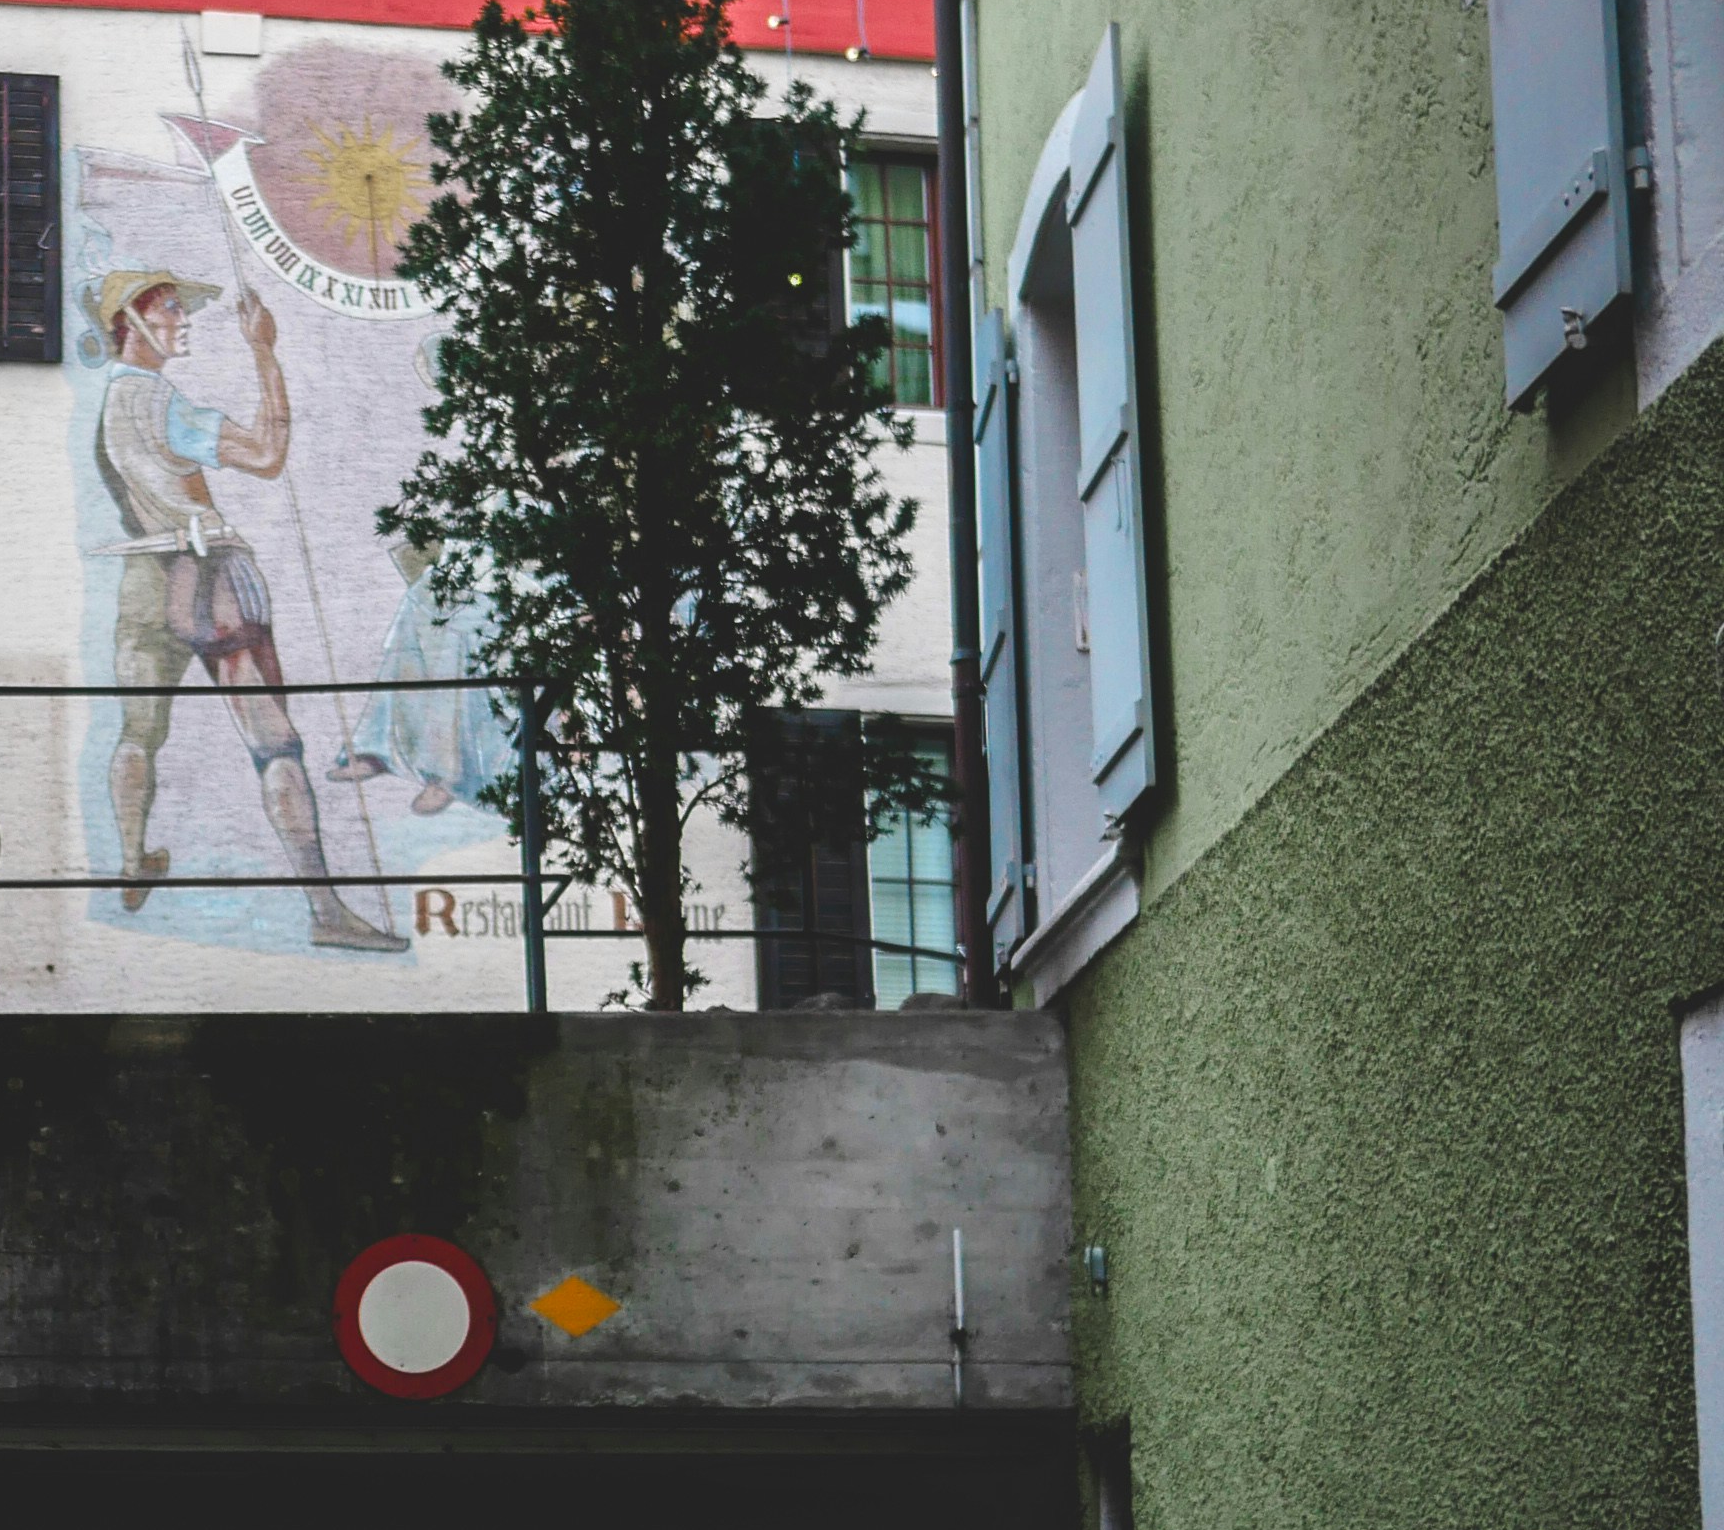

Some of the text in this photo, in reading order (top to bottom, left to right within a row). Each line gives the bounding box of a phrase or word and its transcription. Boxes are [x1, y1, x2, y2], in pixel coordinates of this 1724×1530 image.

[295, 263, 323, 292] IX
[321, 275, 339, 301] X
[340, 281, 365, 308] XI
[368, 286, 398, 311] XII
[414, 887, 593, 937] Restaant
